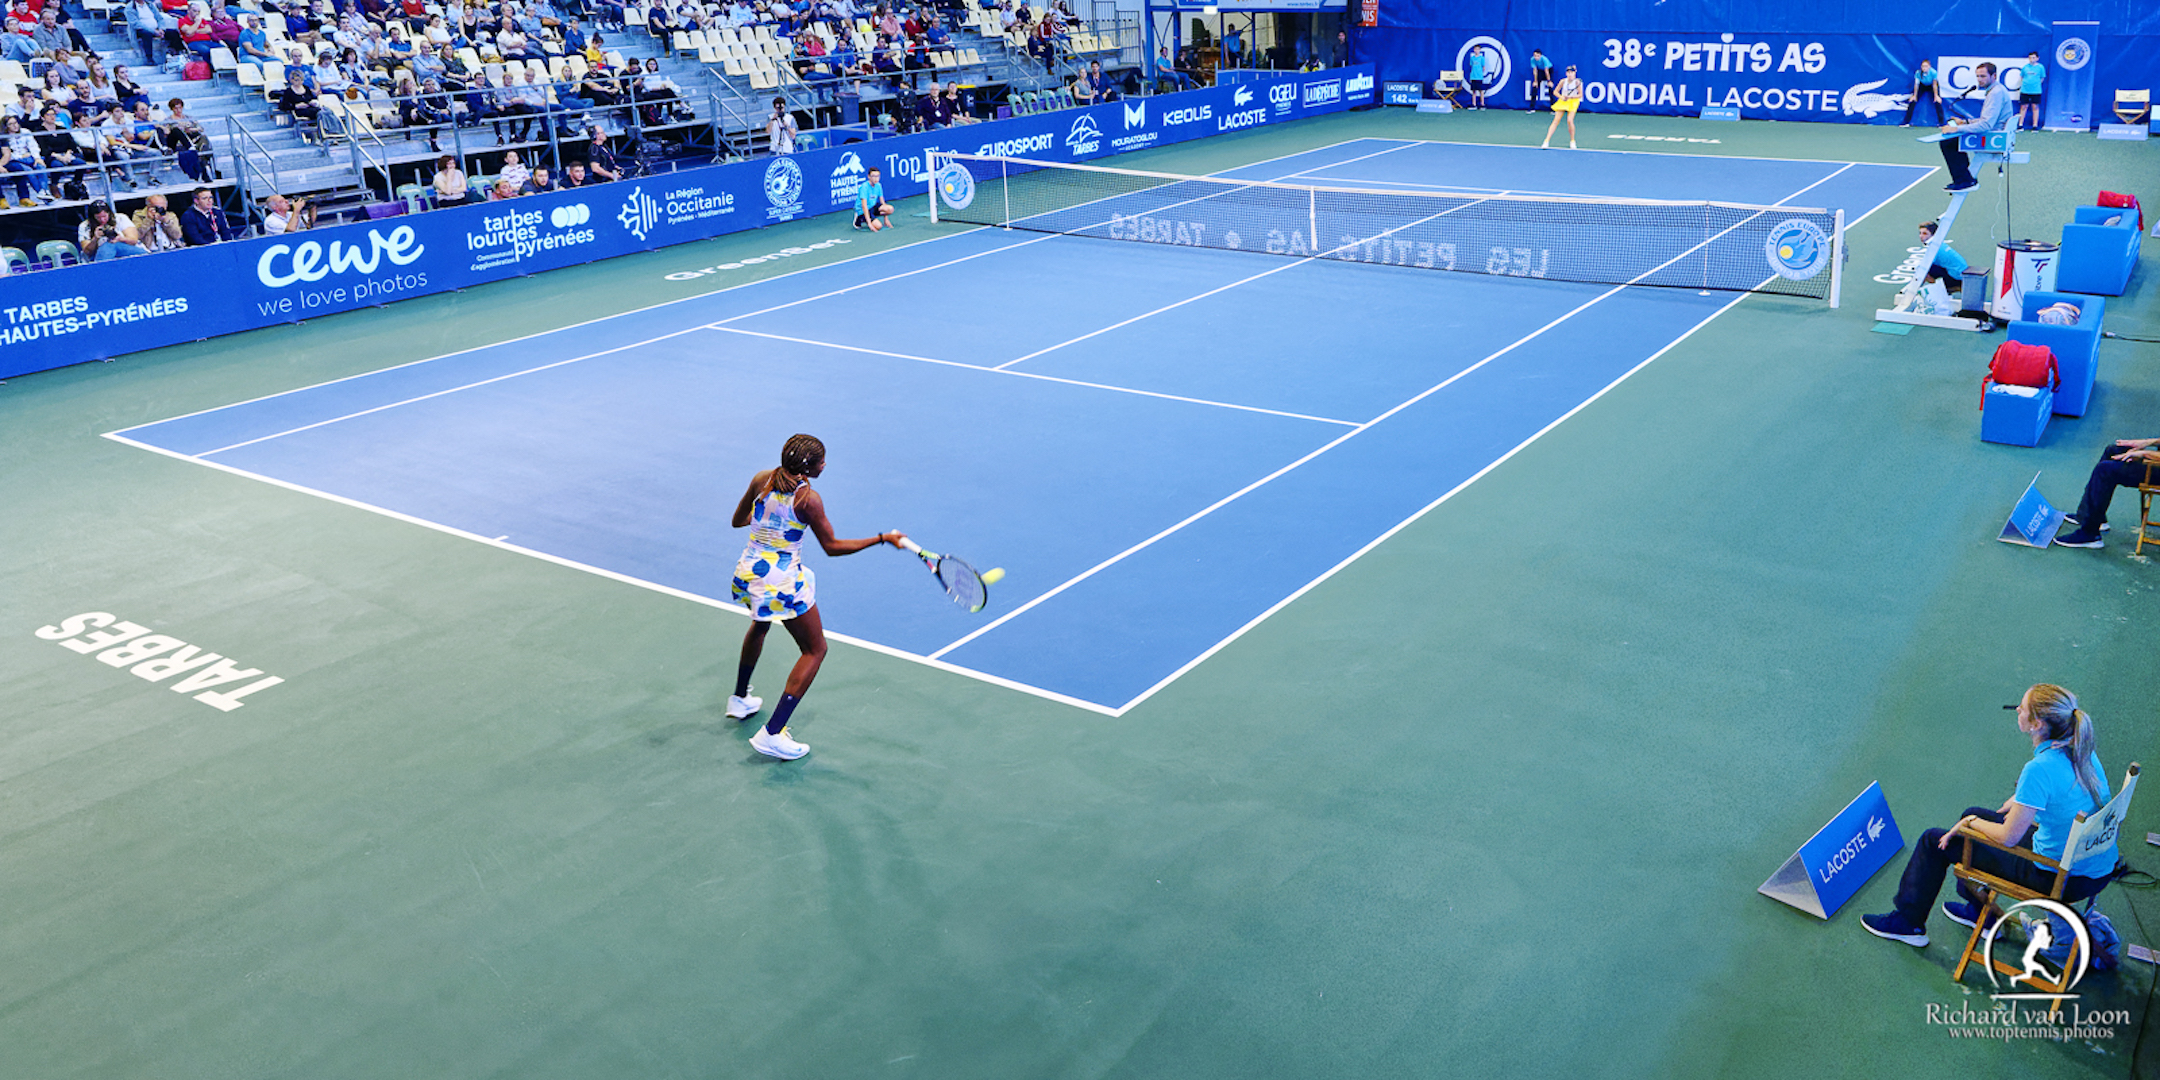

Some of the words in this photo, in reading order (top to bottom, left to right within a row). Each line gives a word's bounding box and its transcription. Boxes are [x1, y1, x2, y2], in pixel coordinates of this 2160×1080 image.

[1777, 42, 1826, 73] AS
[1947, 65, 2022, 92] CC
[1391, 93, 1408, 103] 142
[1580, 80, 1694, 106] ONDIAL
[1706, 87, 1840, 111] LACOSTE
[1218, 107, 1266, 131] LACOSTE
[1111, 131, 1158, 147] MOURATOGLOU
[1964, 134, 2003, 149] CIC
[885, 153, 921, 181] Top
[665, 191, 675, 200] La
[676, 187, 704, 199] Région
[667, 191, 734, 215] Occitanie
[483, 209, 544, 232] tarbes
[467, 225, 538, 250] lourdes
[514, 228, 595, 262] pyrénées
[1769, 222, 1795, 246] TENNIS
[1797, 222, 1826, 248] EUROPE
[257, 225, 425, 288] cewe
[664, 239, 852, 281] GreenSet
[257, 298, 293, 316] we
[300, 288, 347, 309] love
[353, 272, 428, 303] photos
[0, 297, 189, 347] HAUTES-PYRÉNÉES
[4, 296, 89, 324] TARBES
[34, 611, 286, 712] TARBES
[1819, 831, 1867, 884] LACOSTE
